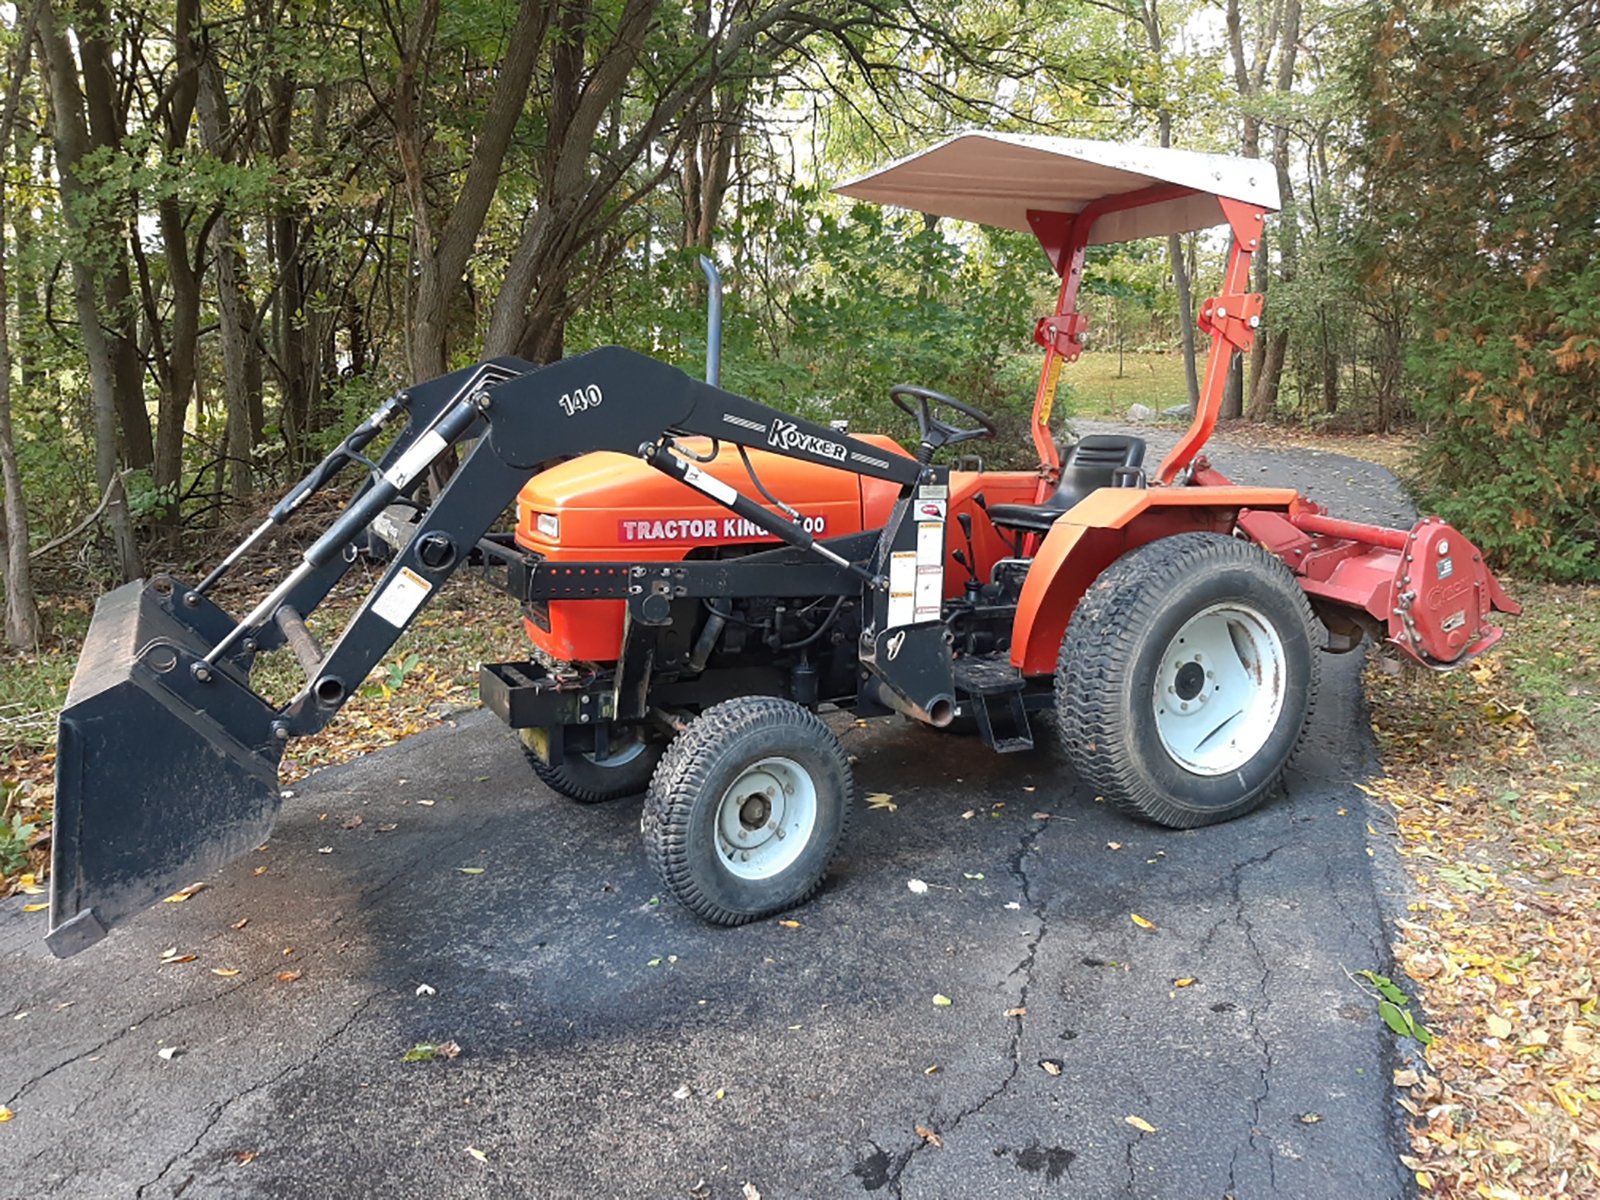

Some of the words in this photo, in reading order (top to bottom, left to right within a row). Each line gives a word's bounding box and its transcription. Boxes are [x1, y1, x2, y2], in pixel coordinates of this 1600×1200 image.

[559, 384, 602, 416] 140
[768, 419, 848, 462] KOYKER
[623, 519, 717, 540] TRACTOR
